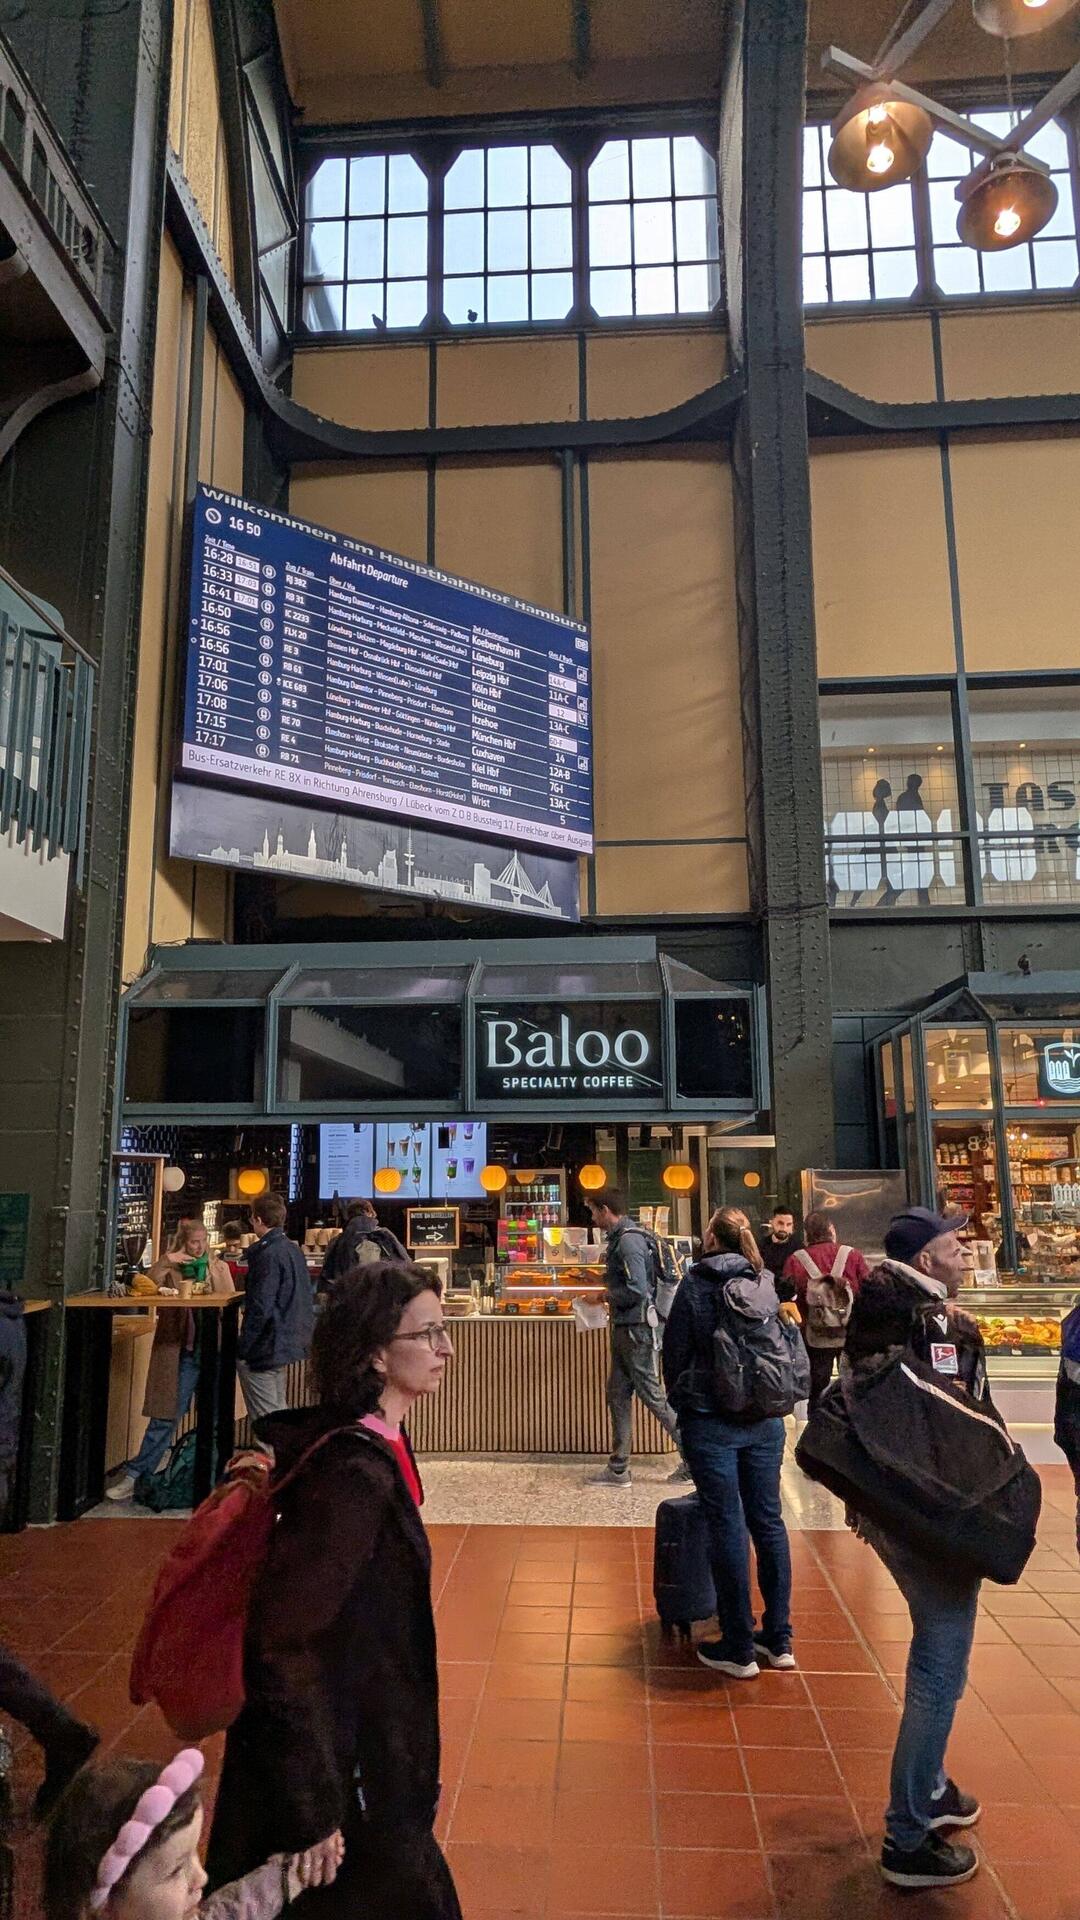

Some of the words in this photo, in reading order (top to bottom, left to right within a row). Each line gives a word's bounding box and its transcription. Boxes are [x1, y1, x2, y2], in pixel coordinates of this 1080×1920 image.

[202, 486, 336, 542] Willkommen
[343, 539, 373, 555] am
[380, 551, 510, 603] Hauptbahnhof
[514, 600, 586, 632] Hamburg
[203, 546, 233, 564] 16:28
[203, 564, 232, 581] 16:33
[202, 582, 231, 600] 16:41
[201, 600, 231, 618] 16:50
[200, 618, 230, 636] 16:56
[199, 636, 229, 654] 16:56
[198, 655, 228, 673] 17:01
[471, 650, 504, 670] Lüneburg
[558, 663, 564, 672] 5
[198, 674, 227, 691] 17:06
[471, 665, 495, 683] Leipzig
[497, 674, 509, 685] Hbf
[471, 681, 488, 694] Köln
[488, 687, 501, 698] Hbf
[548, 690, 569, 704] 11A-C
[197, 692, 226, 709] 17:08
[471, 697, 496, 712] Uelzen
[196, 711, 226, 728] 17:15
[471, 713, 498, 729] Itzehoe
[549, 720, 569, 734] 13A-C
[195, 730, 225, 746] 17:17
[471, 729, 502, 746] München
[503, 738, 515, 749] Hbf
[471, 745, 505, 763] Cuxhaven
[555, 752, 565, 763] 14
[471, 761, 485, 774] Kiel
[486, 765, 499, 777] Hbf
[549, 766, 570, 779] 12A-B
[188, 749, 272, 777] Bus-Ersatzverkehr
[274, 767, 286, 781] RE
[288, 770, 300, 784] 8X
[303, 774, 311, 786] in
[313, 776, 350, 797] Richtung
[351, 785, 397, 807] Ahrensburg
[405, 797, 432, 812] Lübeck
[434, 804, 449, 816] vom
[473, 812, 502, 830] Bussteig
[471, 778, 498, 793] Bremen
[499, 784, 511, 796] Hbf
[471, 794, 489, 807] Wrist
[549, 797, 570, 810] 13A-C
[560, 815, 565, 824] 5
[487, 1013, 649, 1067] Baloo
[503, 1077, 576, 1088] SPECIALTY
[583, 1076, 633, 1087] COFFEE
